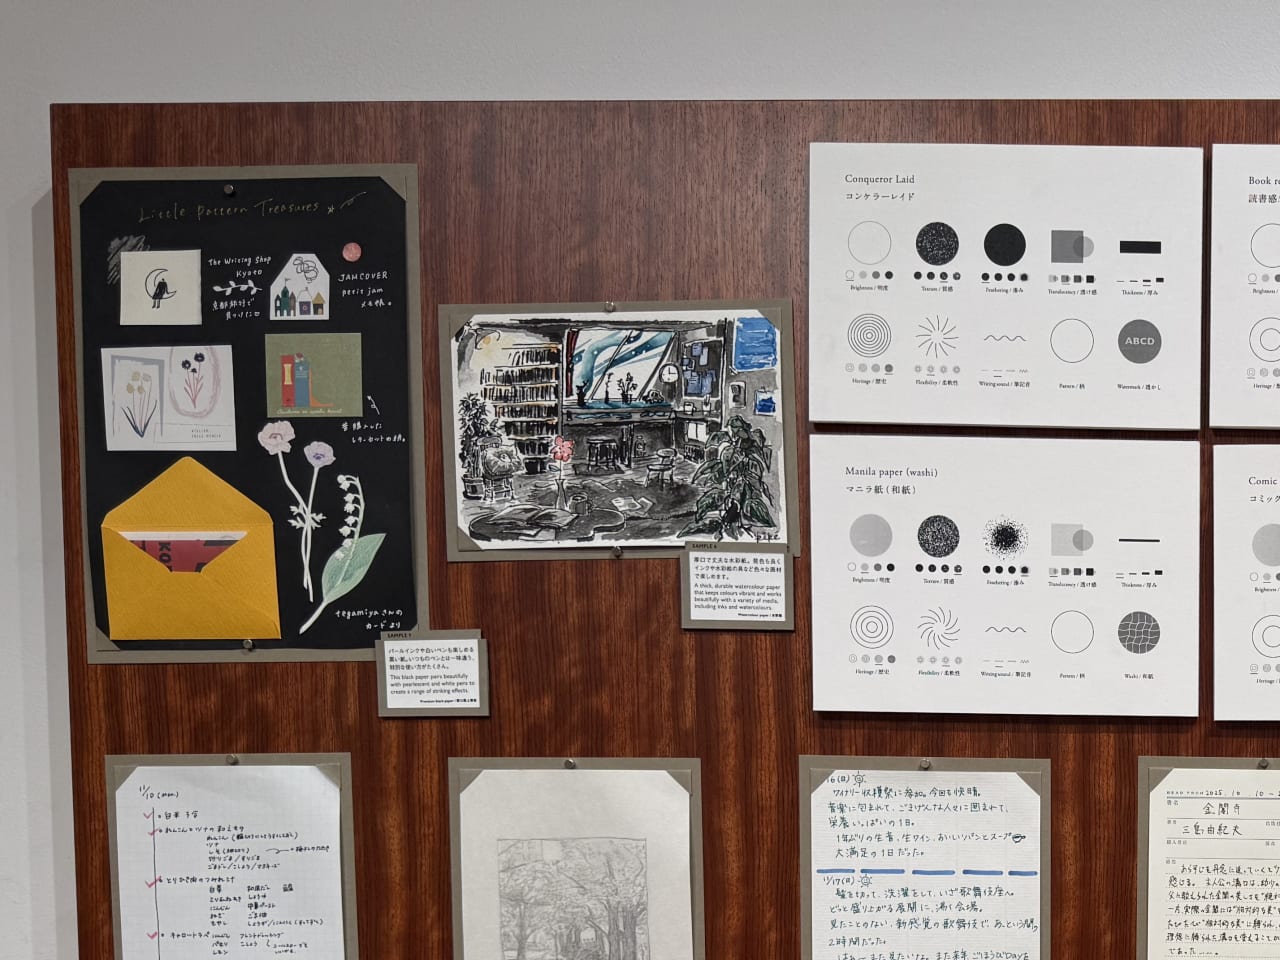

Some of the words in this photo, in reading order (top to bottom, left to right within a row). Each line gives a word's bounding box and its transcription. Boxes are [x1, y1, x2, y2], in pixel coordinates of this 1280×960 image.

[845, 175, 892, 185] Conqueror
[896, 174, 915, 184] Laid
[1249, 176, 1271, 186] Book
[846, 192, 915, 201] コンケラーレイド
[138, 202, 185, 223] Little
[254, 198, 320, 216] Treasures
[208, 258, 221, 266] The
[224, 256, 252, 267] Writing
[255, 255, 272, 266] Shop
[337, 271, 388, 282] JAMCOVER
[367, 286, 384, 295] jam
[1124, 337, 1155, 346] ABCD
[845, 467, 876, 477] Manila
[879, 468, 903, 478] paper
[906, 467, 938, 478] (washi)
[1248, 476, 1277, 486] Comic
[336, 609, 379, 619] tegamiya
[1202, 802, 1241, 815] 金閣寺
[1182, 822, 1242, 836] 三島由紀夫
